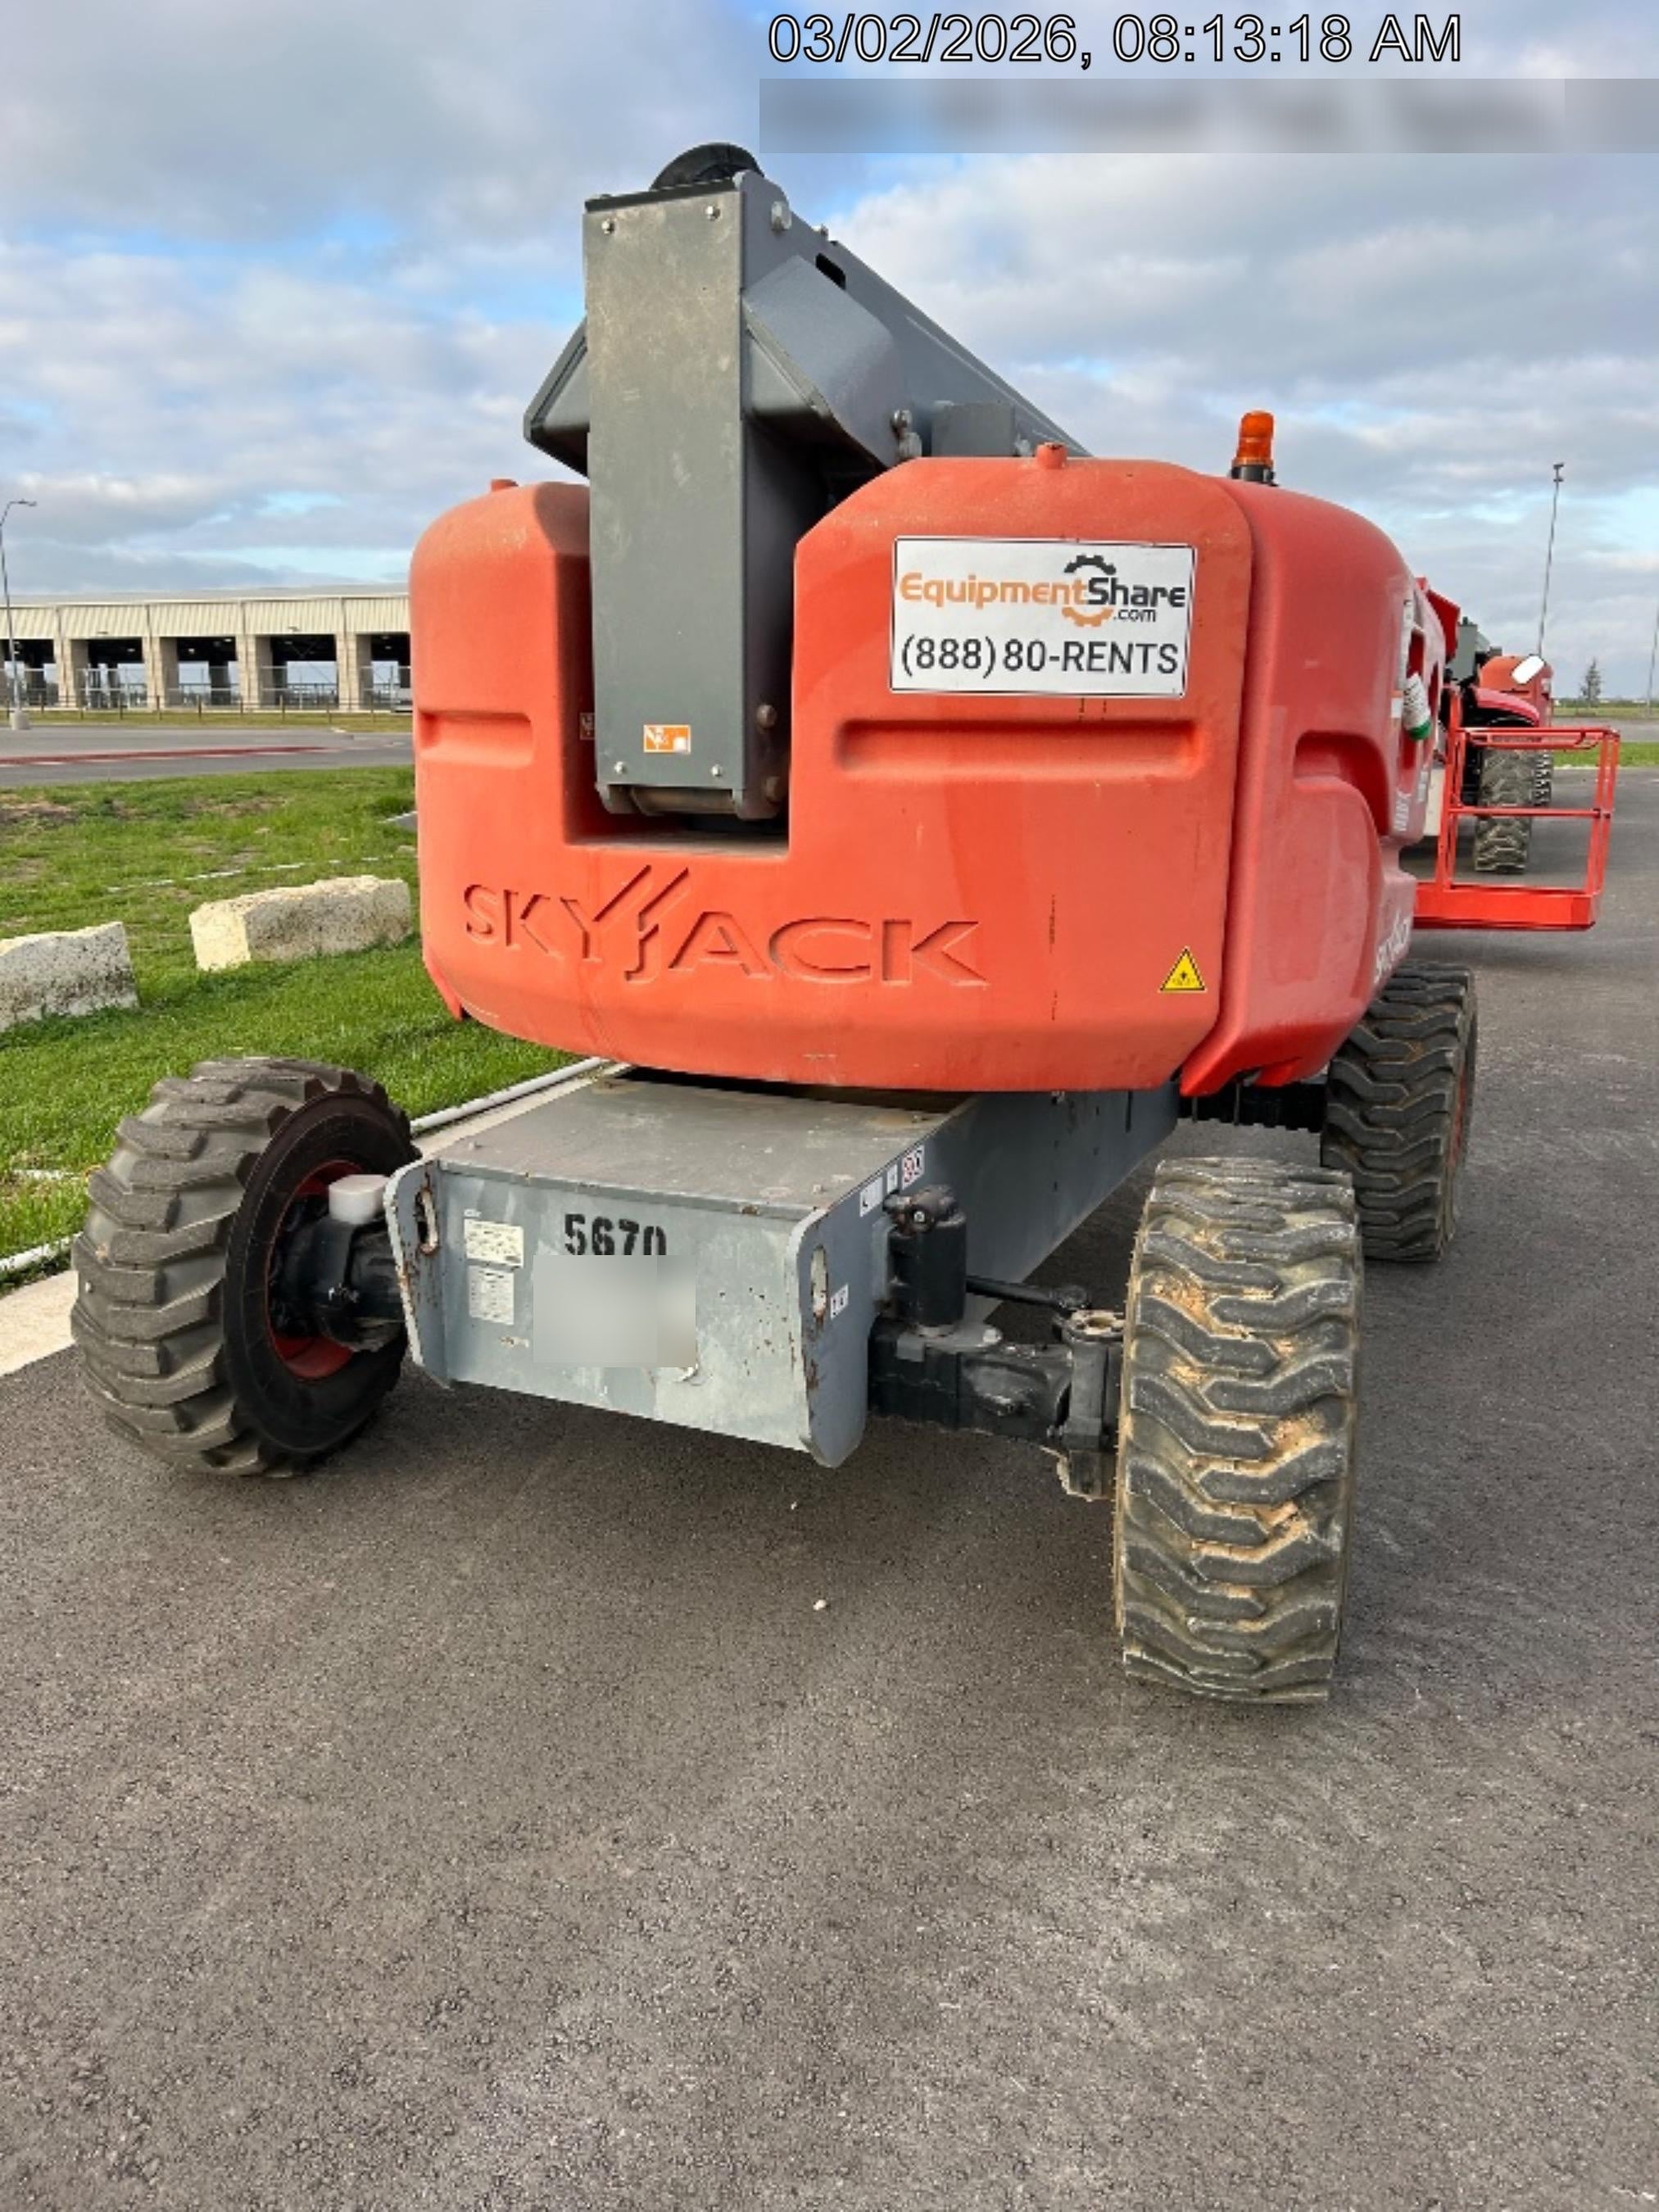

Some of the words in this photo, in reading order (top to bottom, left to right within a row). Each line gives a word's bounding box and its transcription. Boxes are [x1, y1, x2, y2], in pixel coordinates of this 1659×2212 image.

[900, 572, 1185, 610] EquipmentShare
[1113, 609, 1157, 623] .com
[463, 864, 989, 988] SKYJACK
